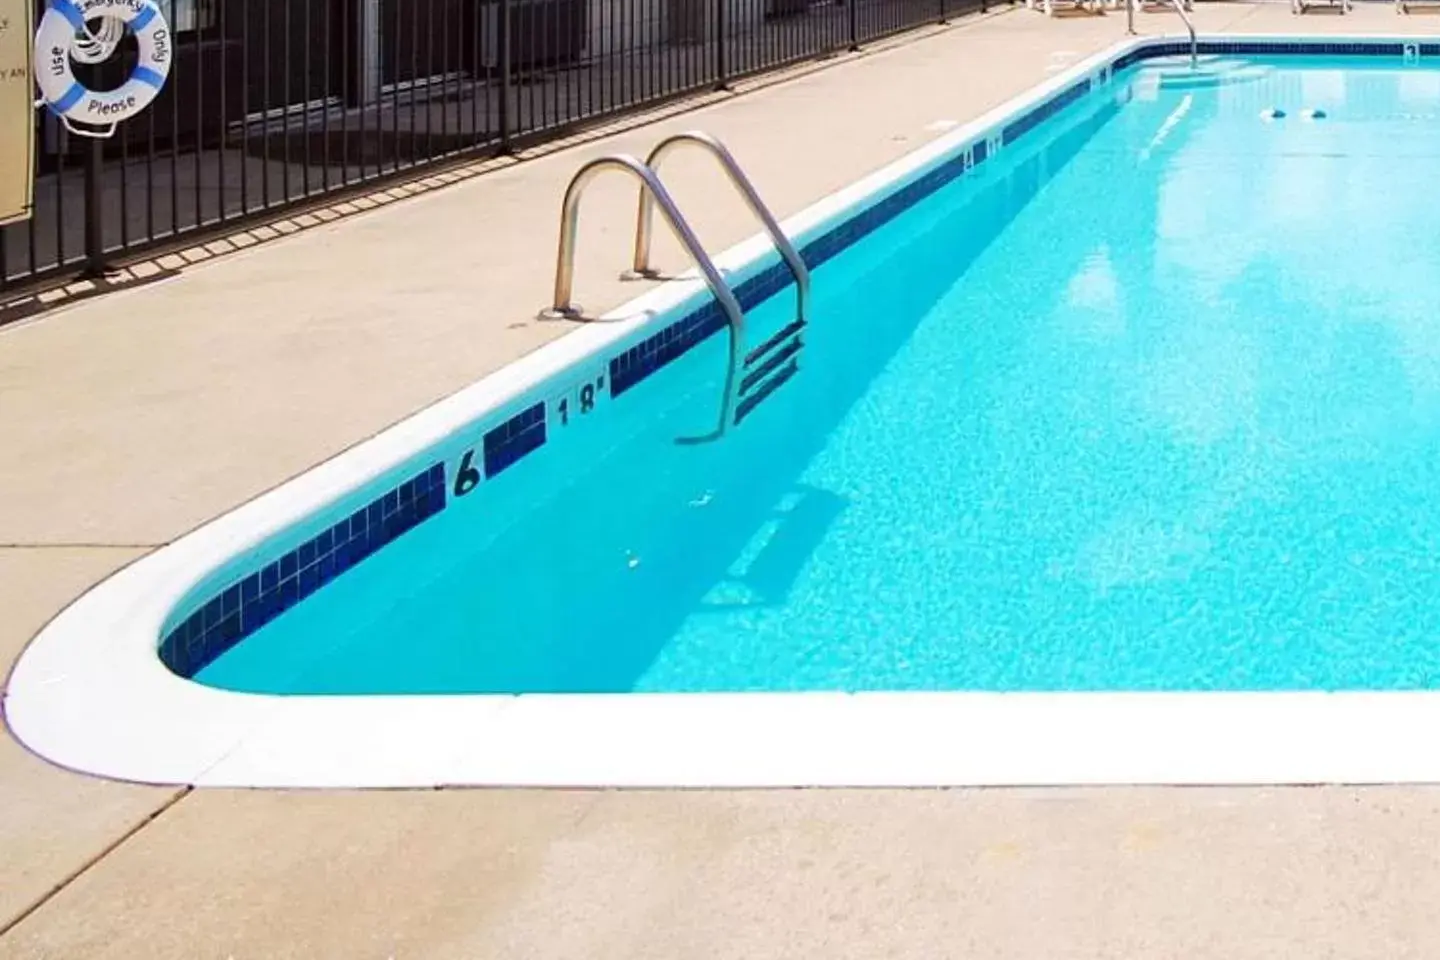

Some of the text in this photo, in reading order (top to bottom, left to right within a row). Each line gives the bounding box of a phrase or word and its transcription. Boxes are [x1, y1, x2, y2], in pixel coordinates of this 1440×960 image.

[151, 29, 169, 63] Only
[87, 96, 136, 115] Please
[453, 448, 481, 497] 6
